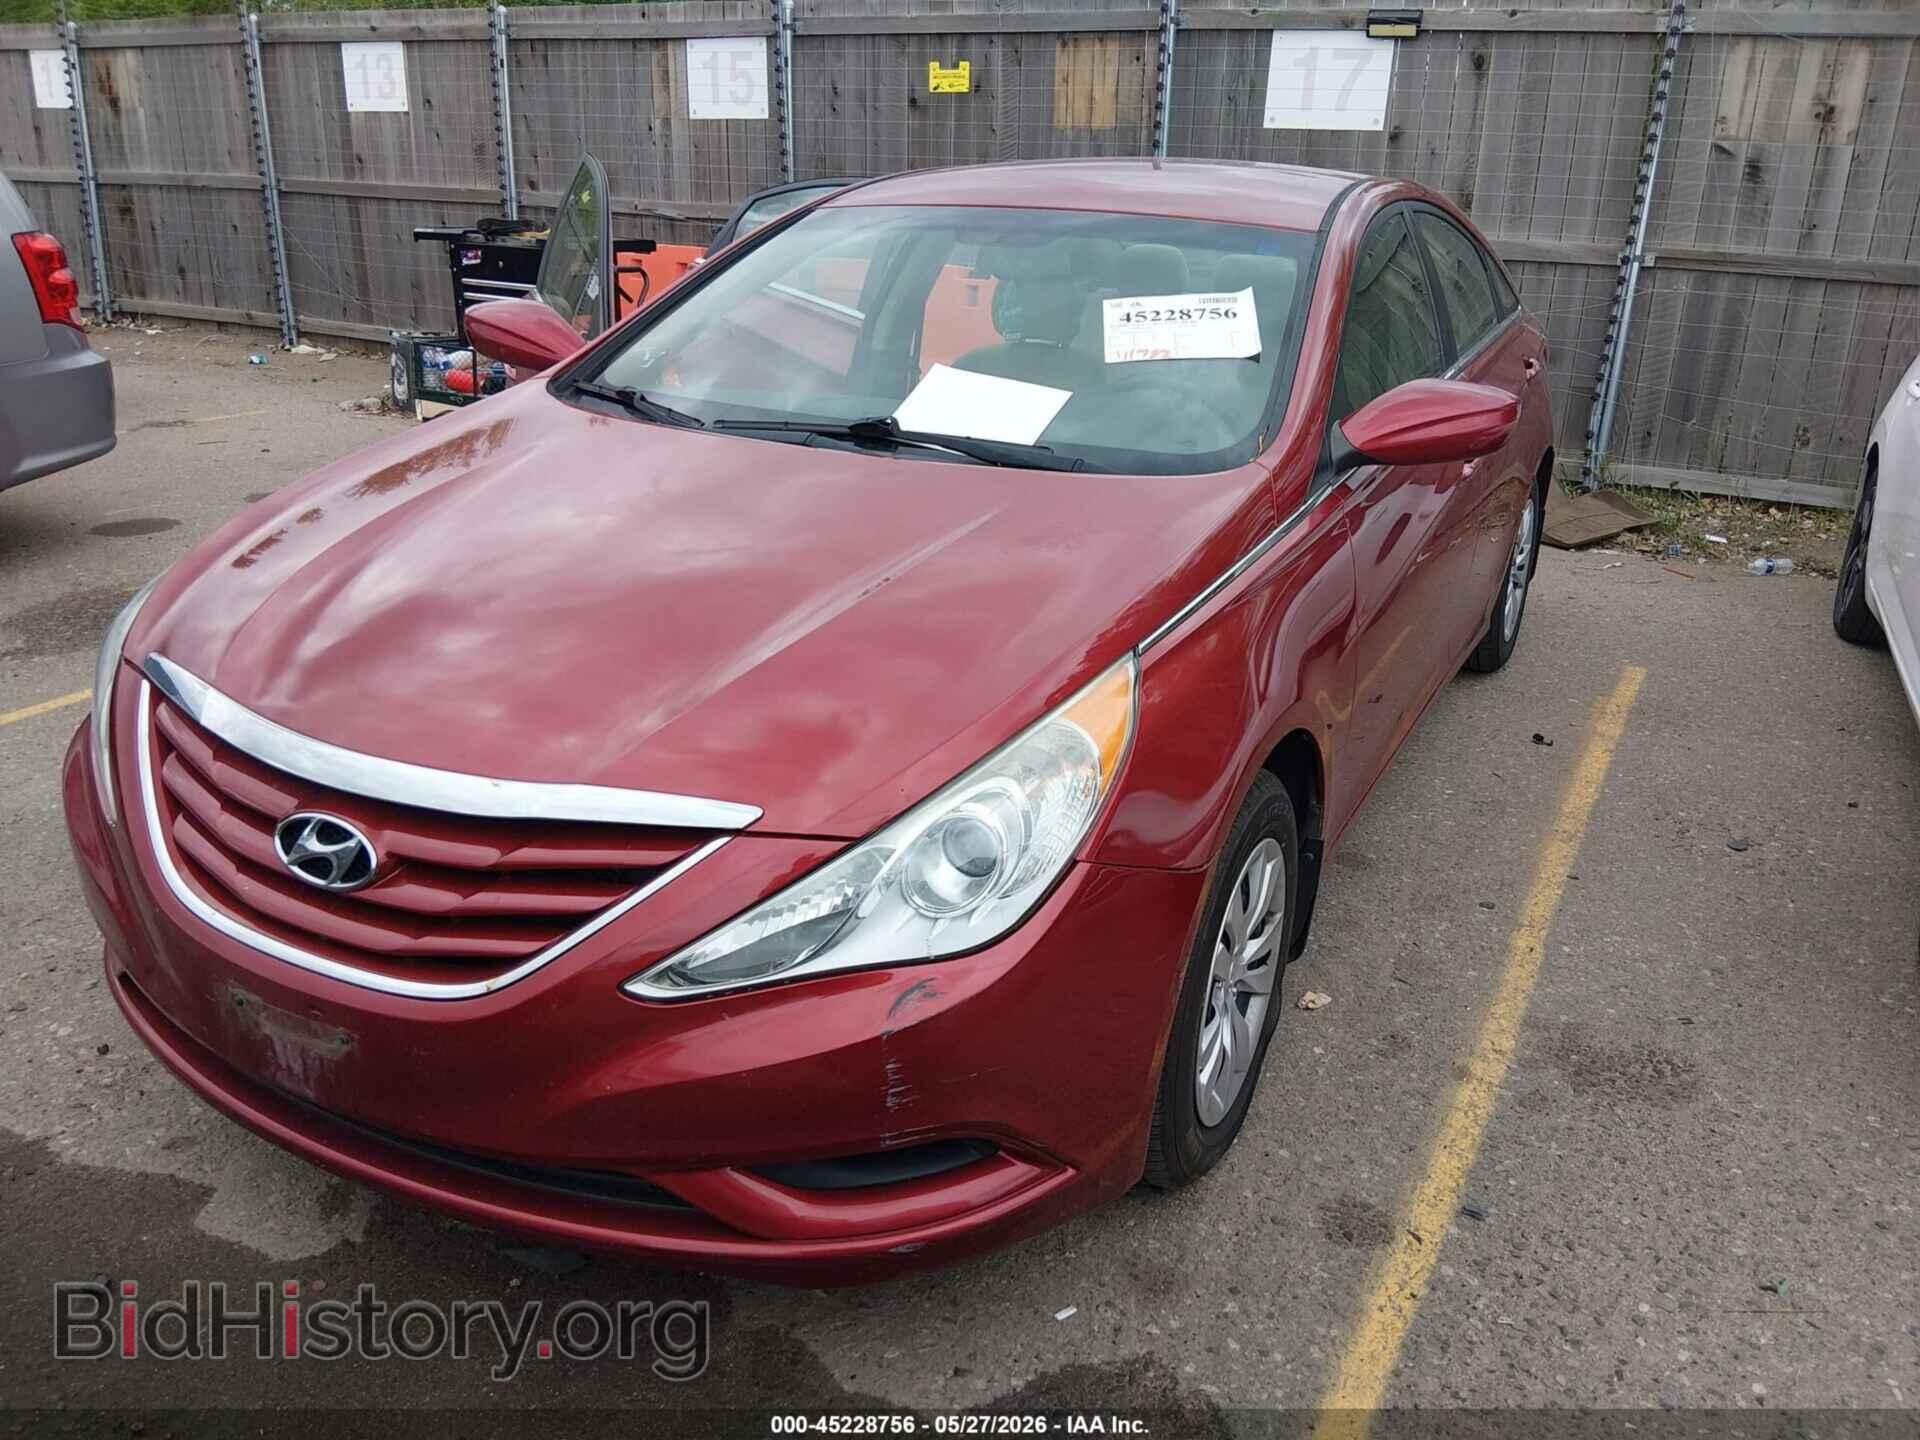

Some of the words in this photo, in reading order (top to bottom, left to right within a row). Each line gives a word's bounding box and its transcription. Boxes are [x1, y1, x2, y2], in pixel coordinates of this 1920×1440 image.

[353, 53, 397, 99] 13
[701, 50, 755, 106] 15
[1293, 46, 1374, 111] 17
[1120, 307, 1237, 323] 45228756
